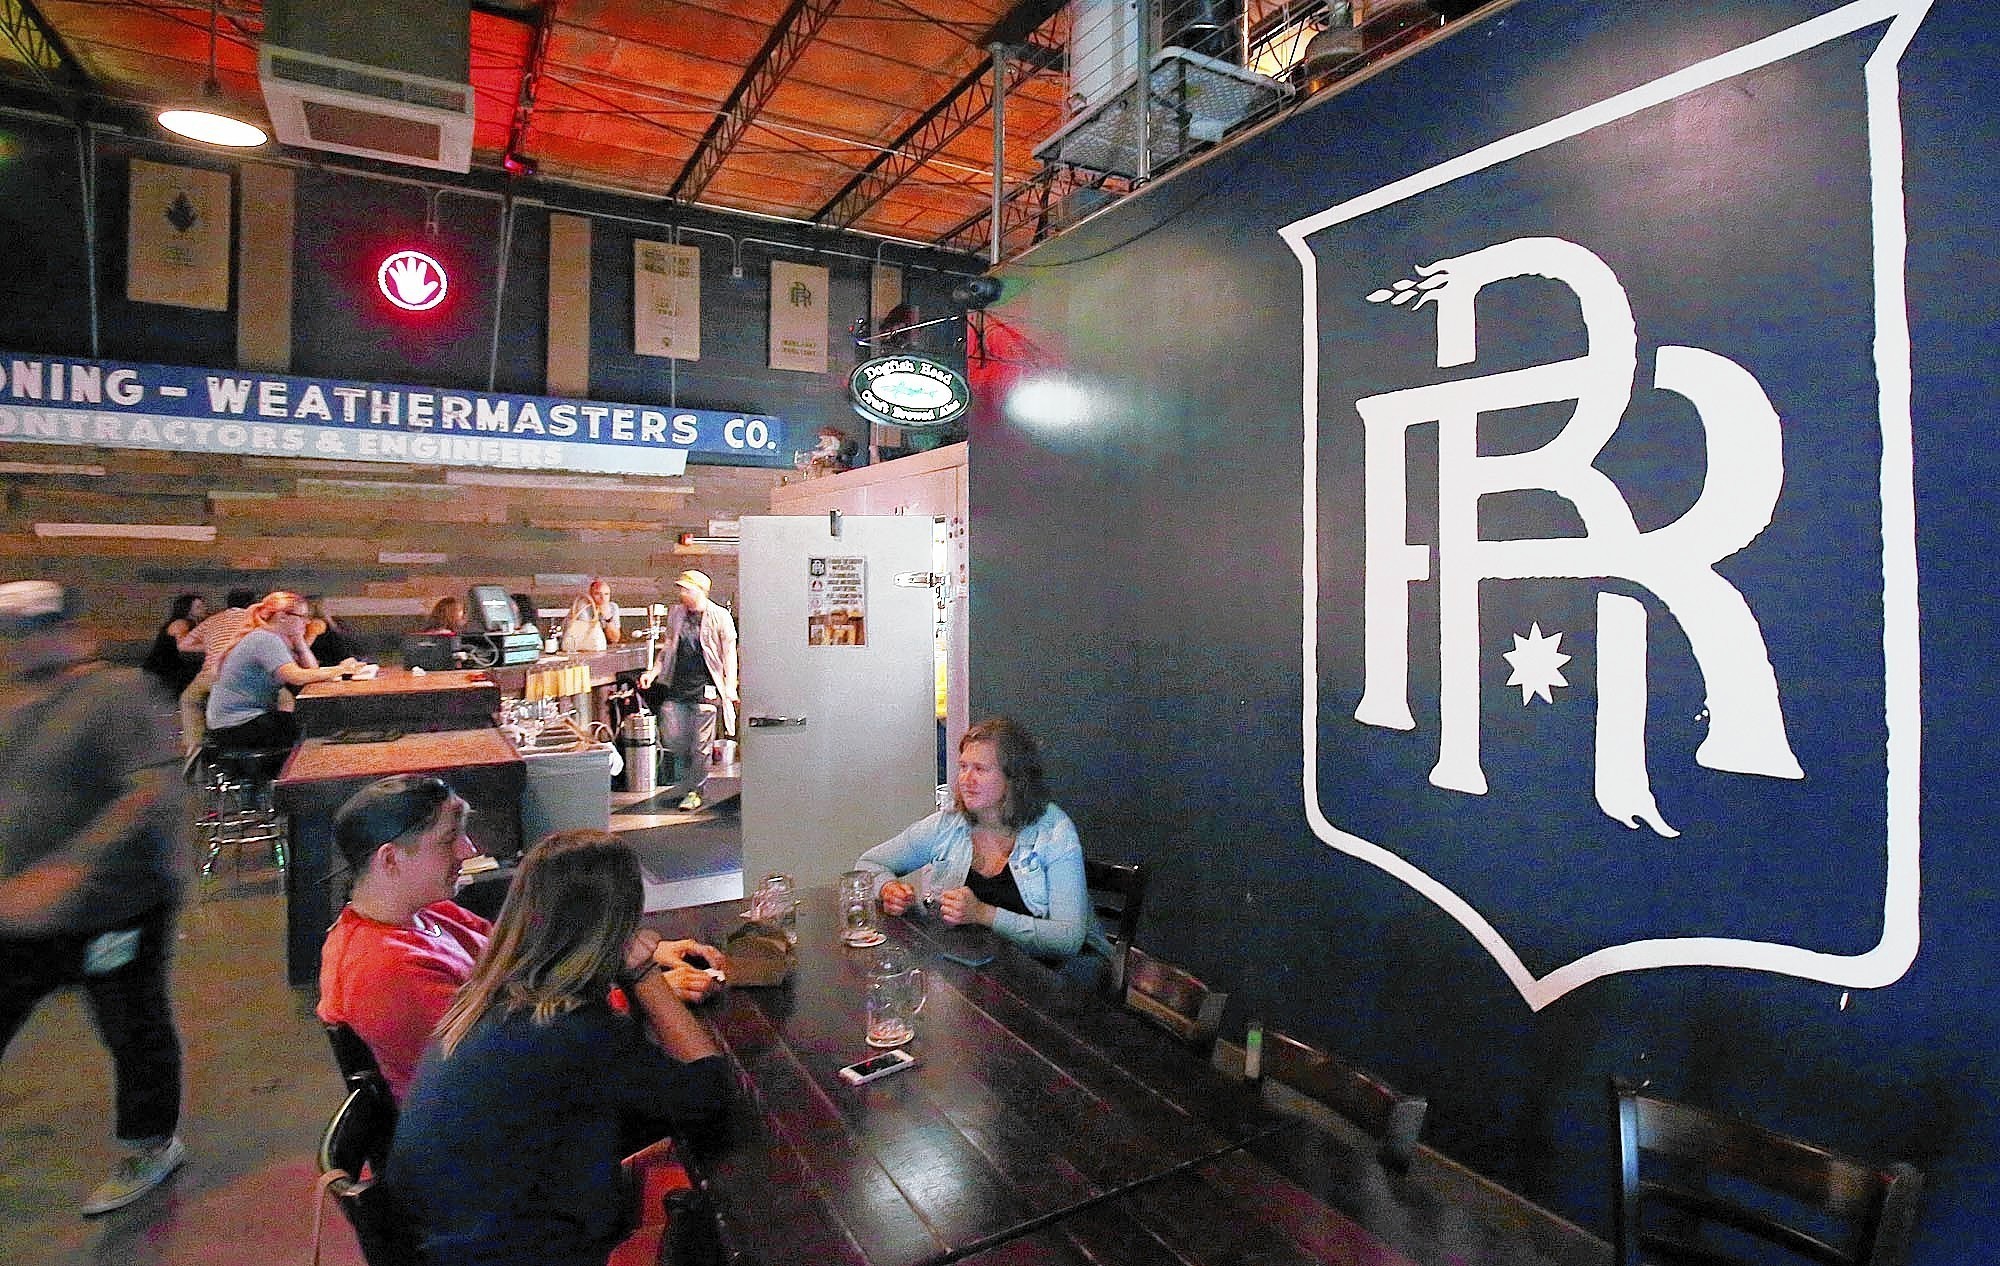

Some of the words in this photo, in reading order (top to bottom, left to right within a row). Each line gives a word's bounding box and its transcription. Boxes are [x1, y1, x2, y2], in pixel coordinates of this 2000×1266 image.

[0, 360, 144, 406] NING
[206, 376, 699, 445] WEATHERMASTERS
[724, 418, 777, 450] CO.
[316, 429, 345, 453] &
[358, 431, 562, 465] ENGINEERS
